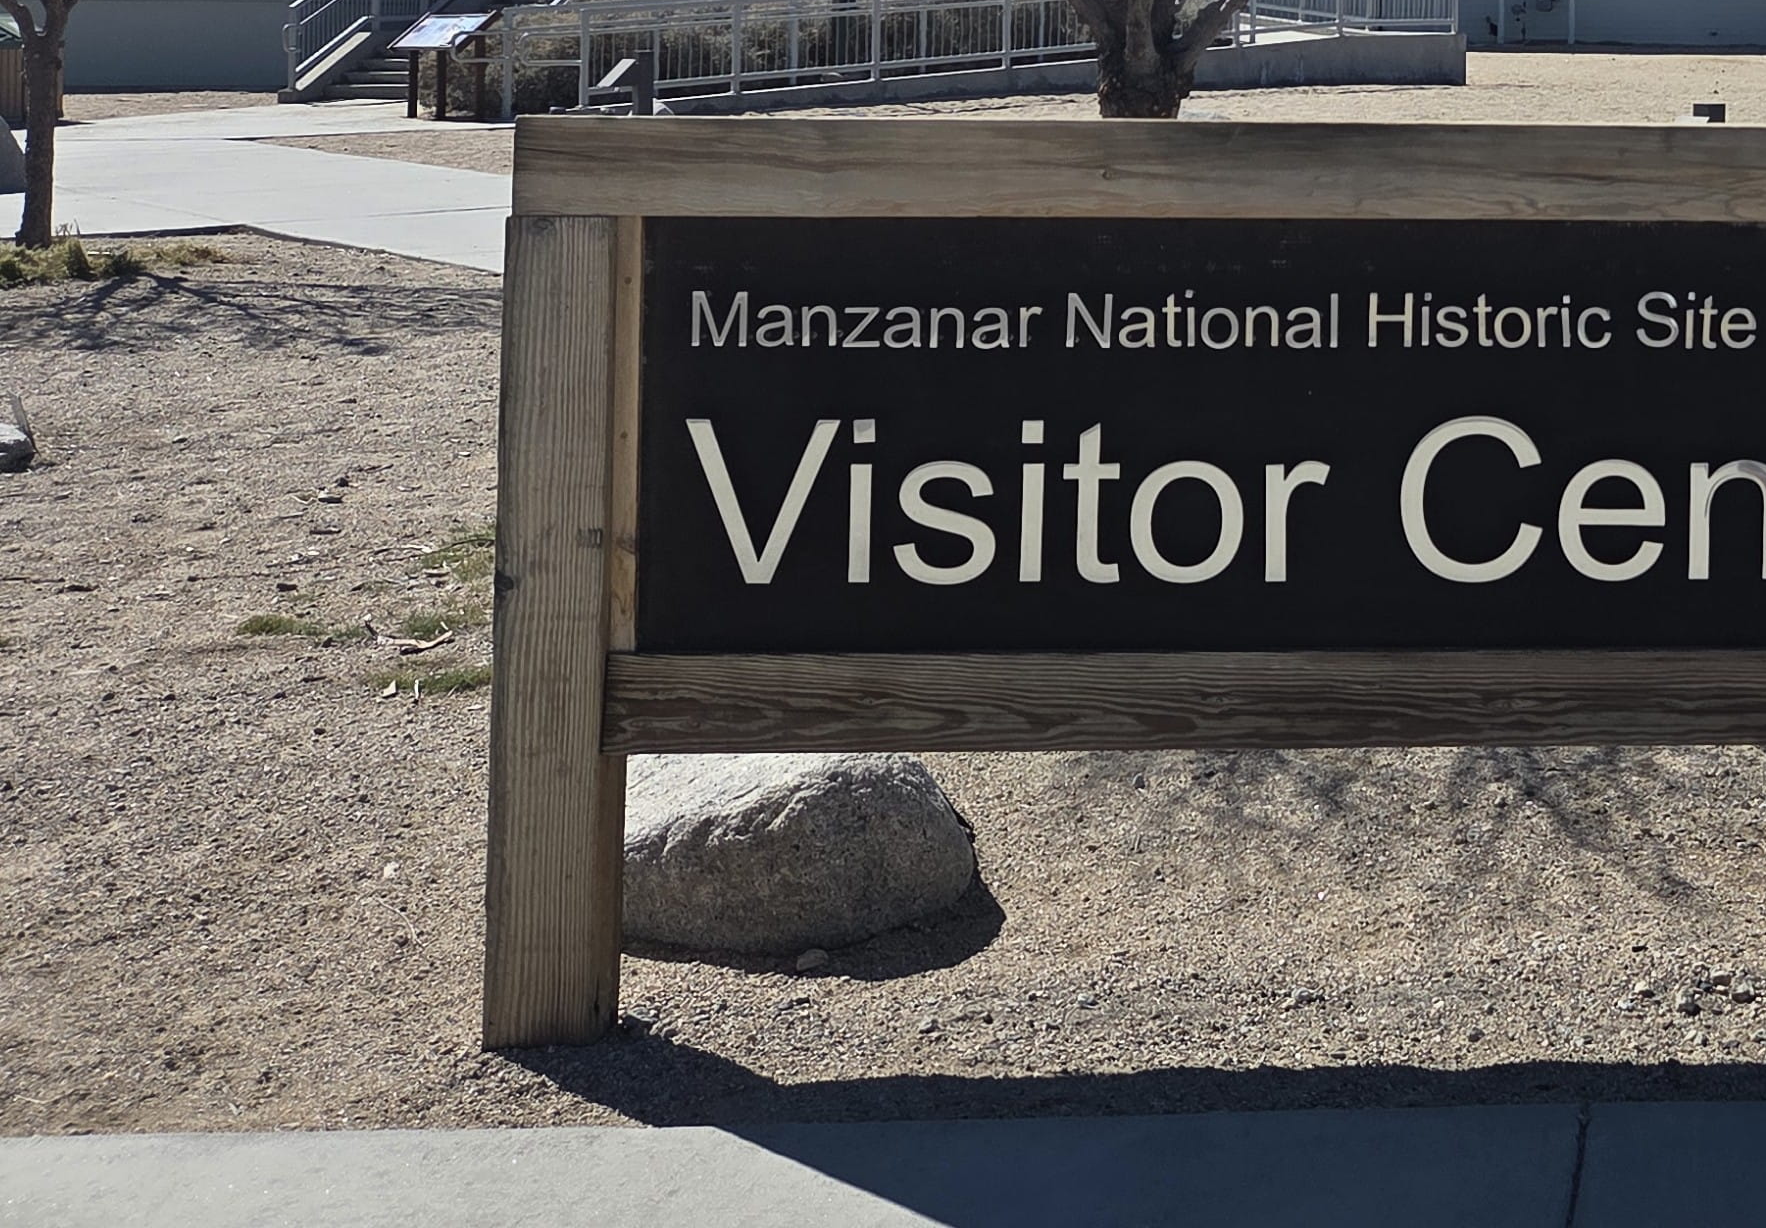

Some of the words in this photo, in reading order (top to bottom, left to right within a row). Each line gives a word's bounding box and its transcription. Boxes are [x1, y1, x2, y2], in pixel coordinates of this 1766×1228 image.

[691, 289, 1043, 350] Manzanar
[1065, 289, 1339, 350] National
[1367, 291, 1613, 349] Historic
[1636, 291, 1757, 350] Site
[685, 417, 1331, 586] Visitor
